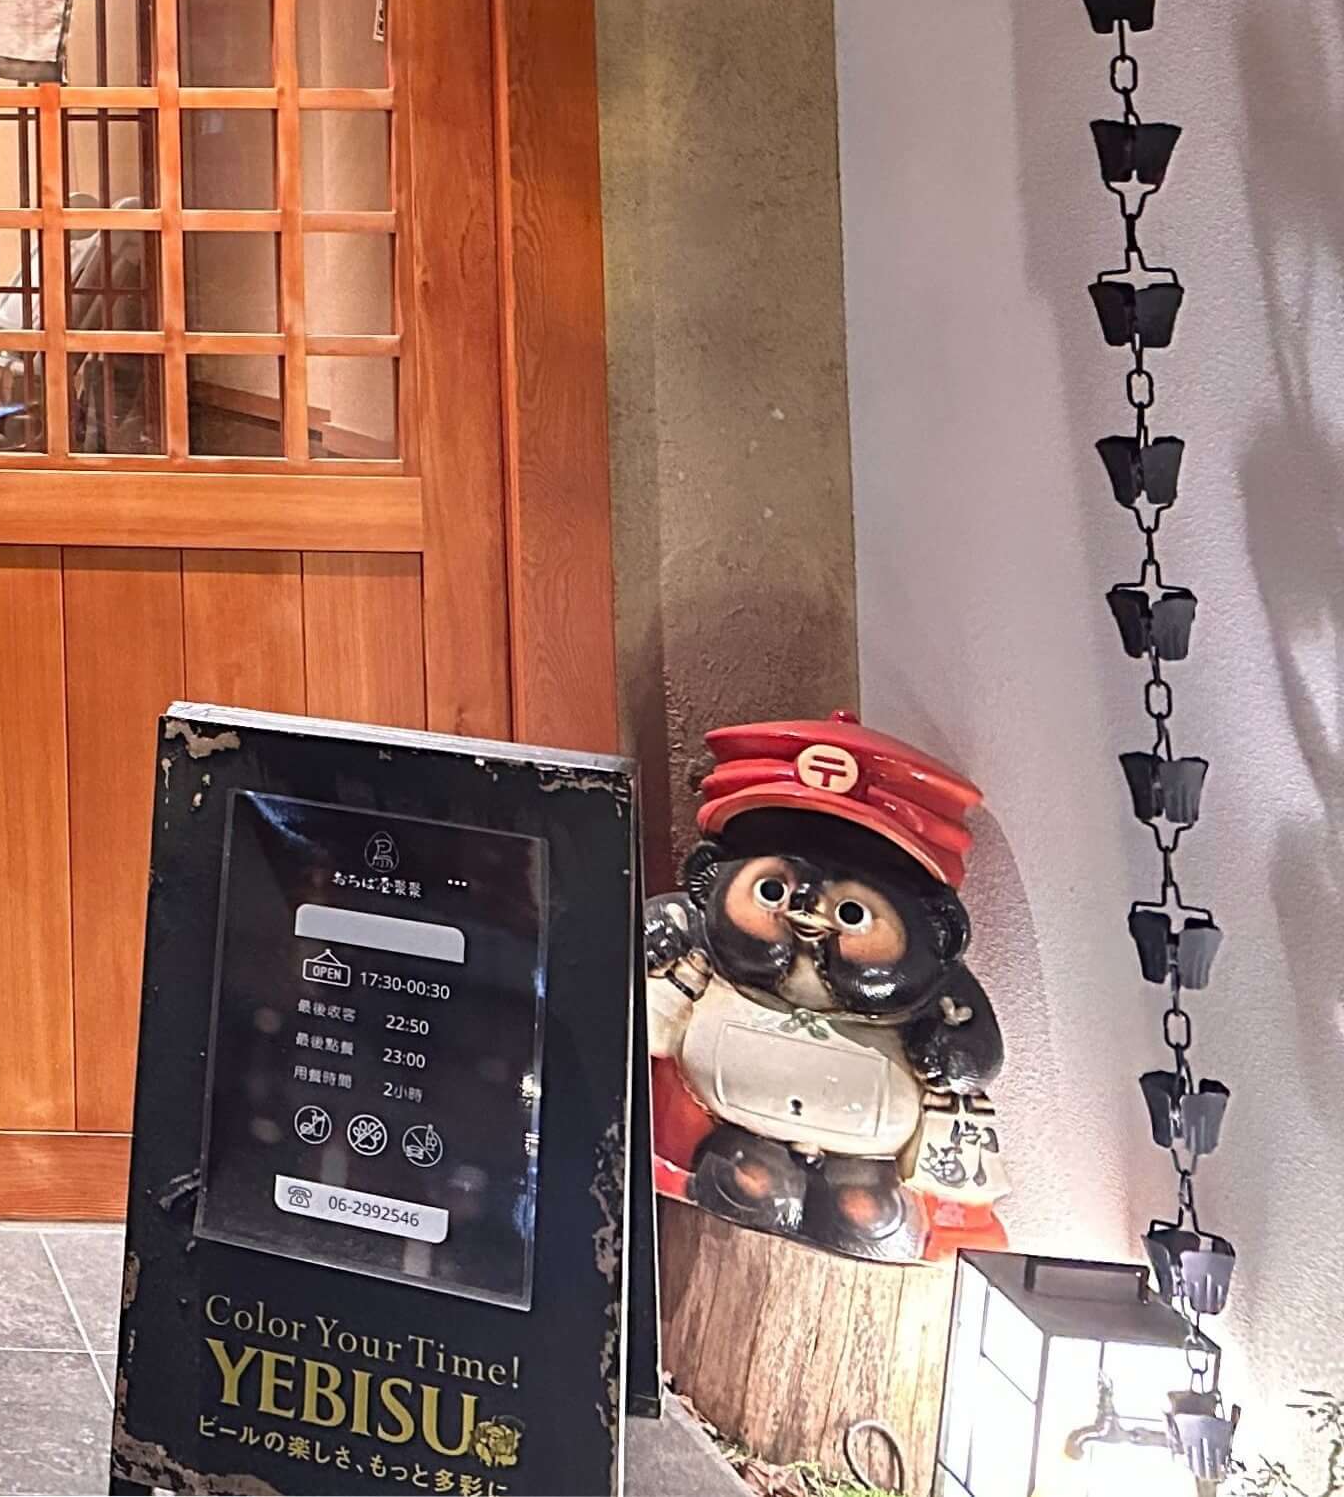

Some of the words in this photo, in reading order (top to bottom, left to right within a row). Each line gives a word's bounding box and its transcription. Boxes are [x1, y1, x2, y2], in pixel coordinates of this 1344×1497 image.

[311, 965, 343, 982] OPEN
[360, 971, 450, 1000] 17:30-00:30
[384, 1014, 430, 1035] 22:50
[382, 1047, 426, 1069] 23:00
[327, 1195, 420, 1228] 06-2992546
[205, 1294, 307, 1342] Color
[315, 1315, 403, 1363] Your
[407, 1335, 521, 1390] Time!
[205, 1337, 479, 1457] YEBISU
